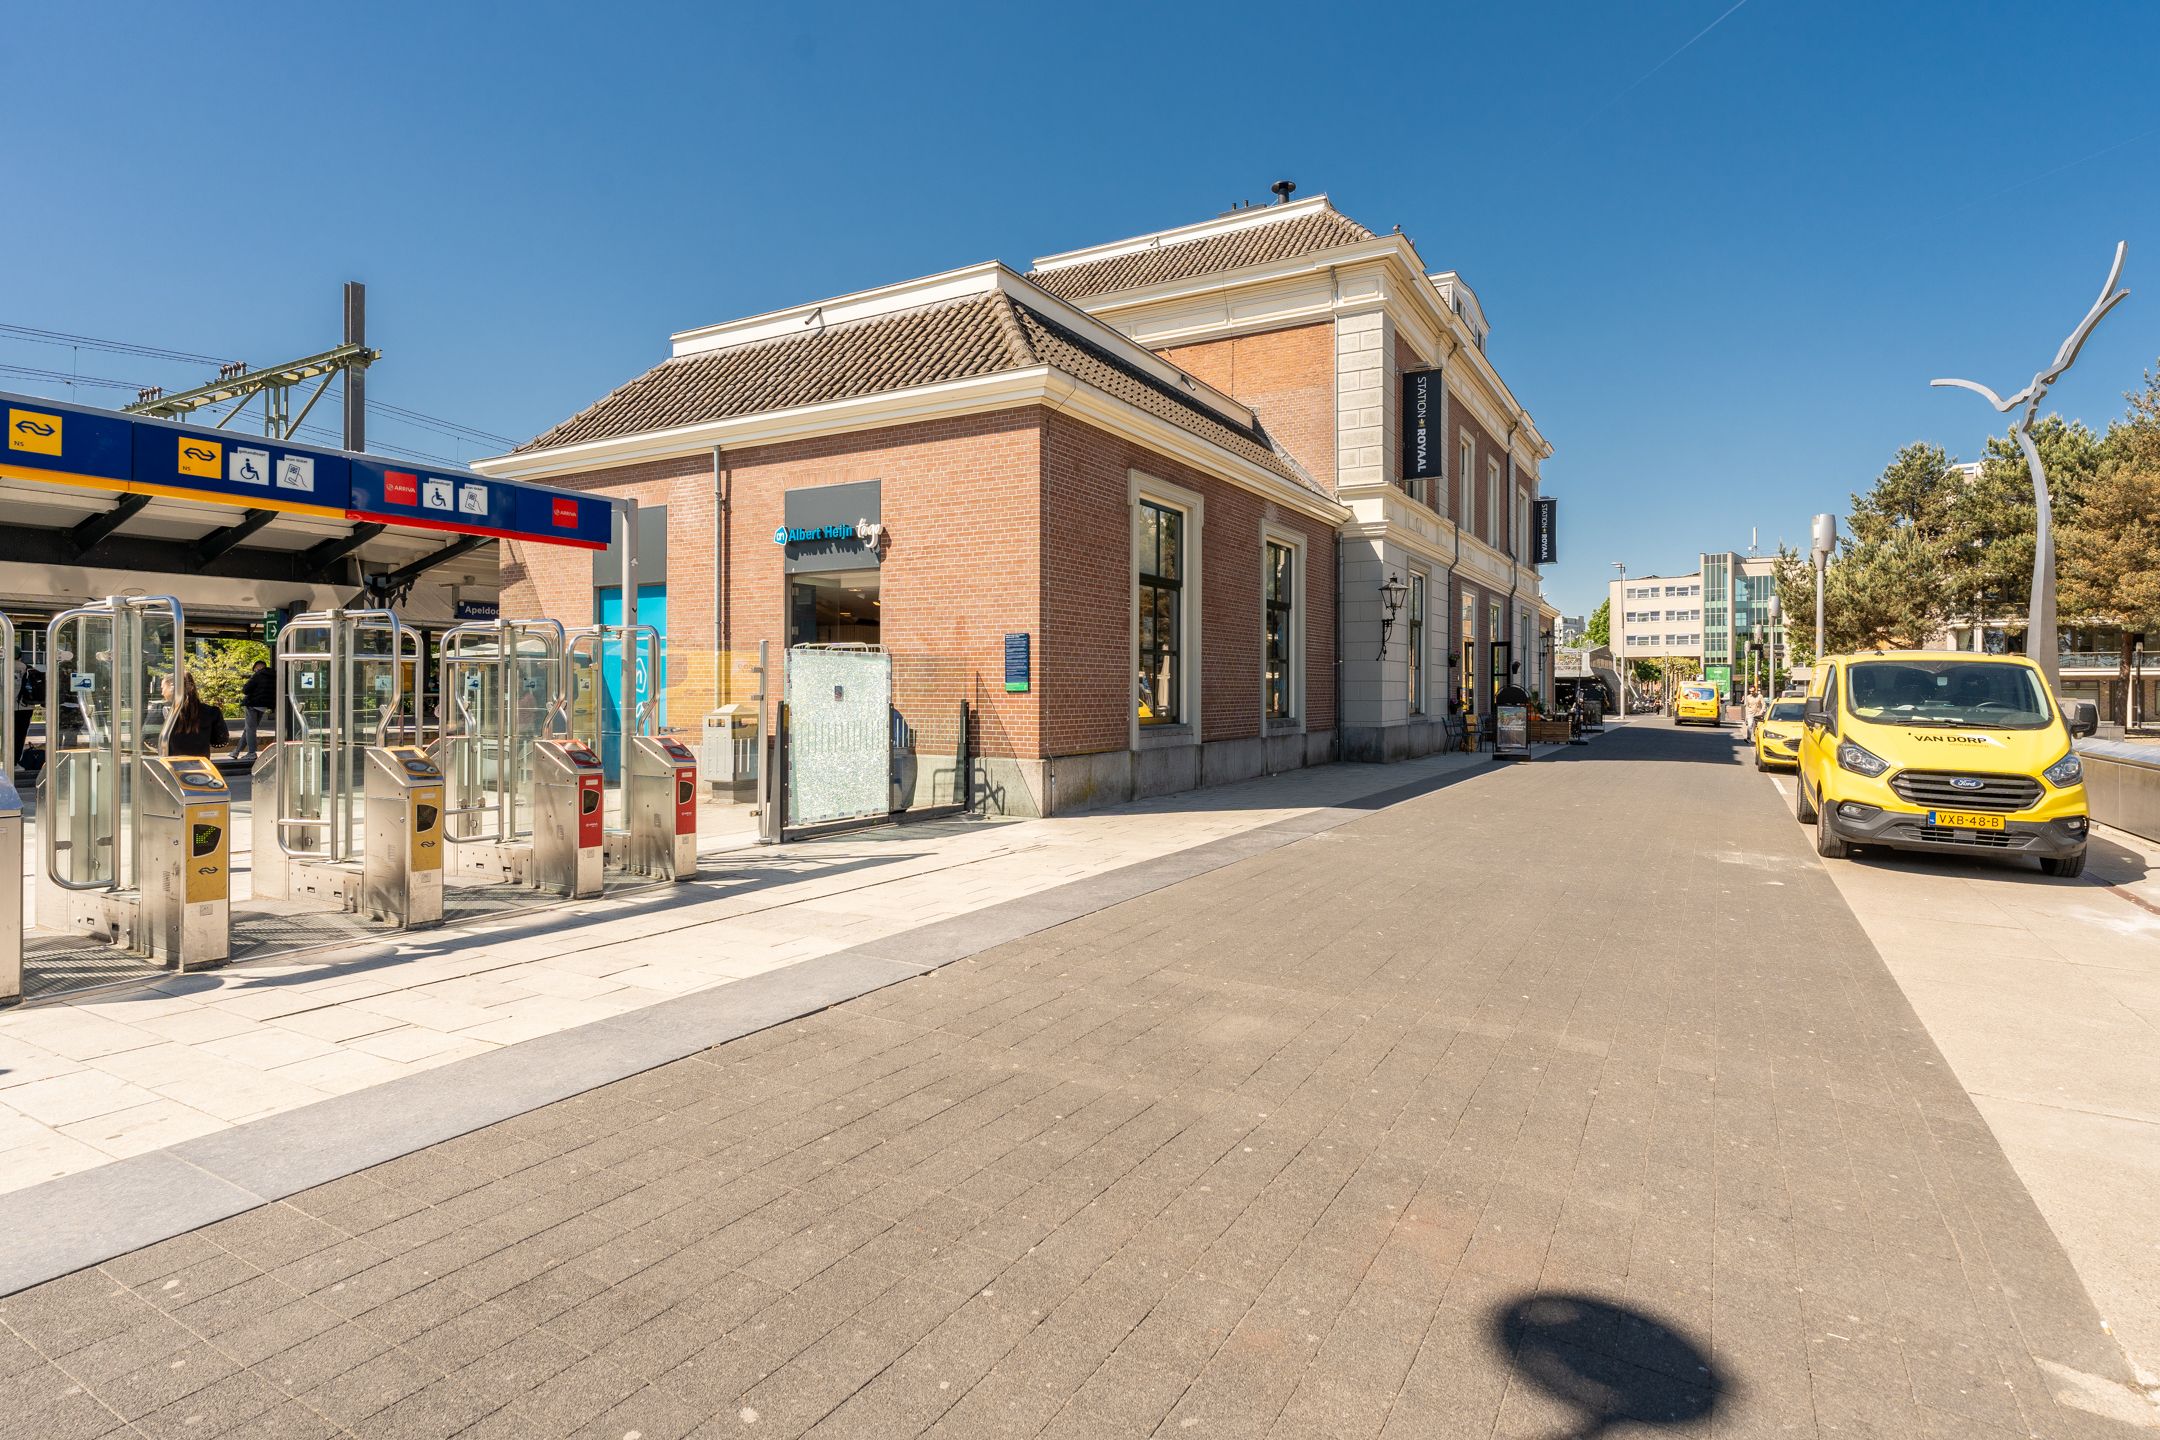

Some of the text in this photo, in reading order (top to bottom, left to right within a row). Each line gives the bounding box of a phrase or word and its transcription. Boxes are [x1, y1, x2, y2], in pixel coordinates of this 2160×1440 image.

[1417, 376, 1427, 473] STATION ROYAAL
[394, 485, 416, 493] ARRIVA
[788, 528, 822, 541] Albert
[824, 523, 853, 539] Heijn
[1946, 736, 1987, 744] DORP
[1939, 814, 1999, 828] VXB-48-B
